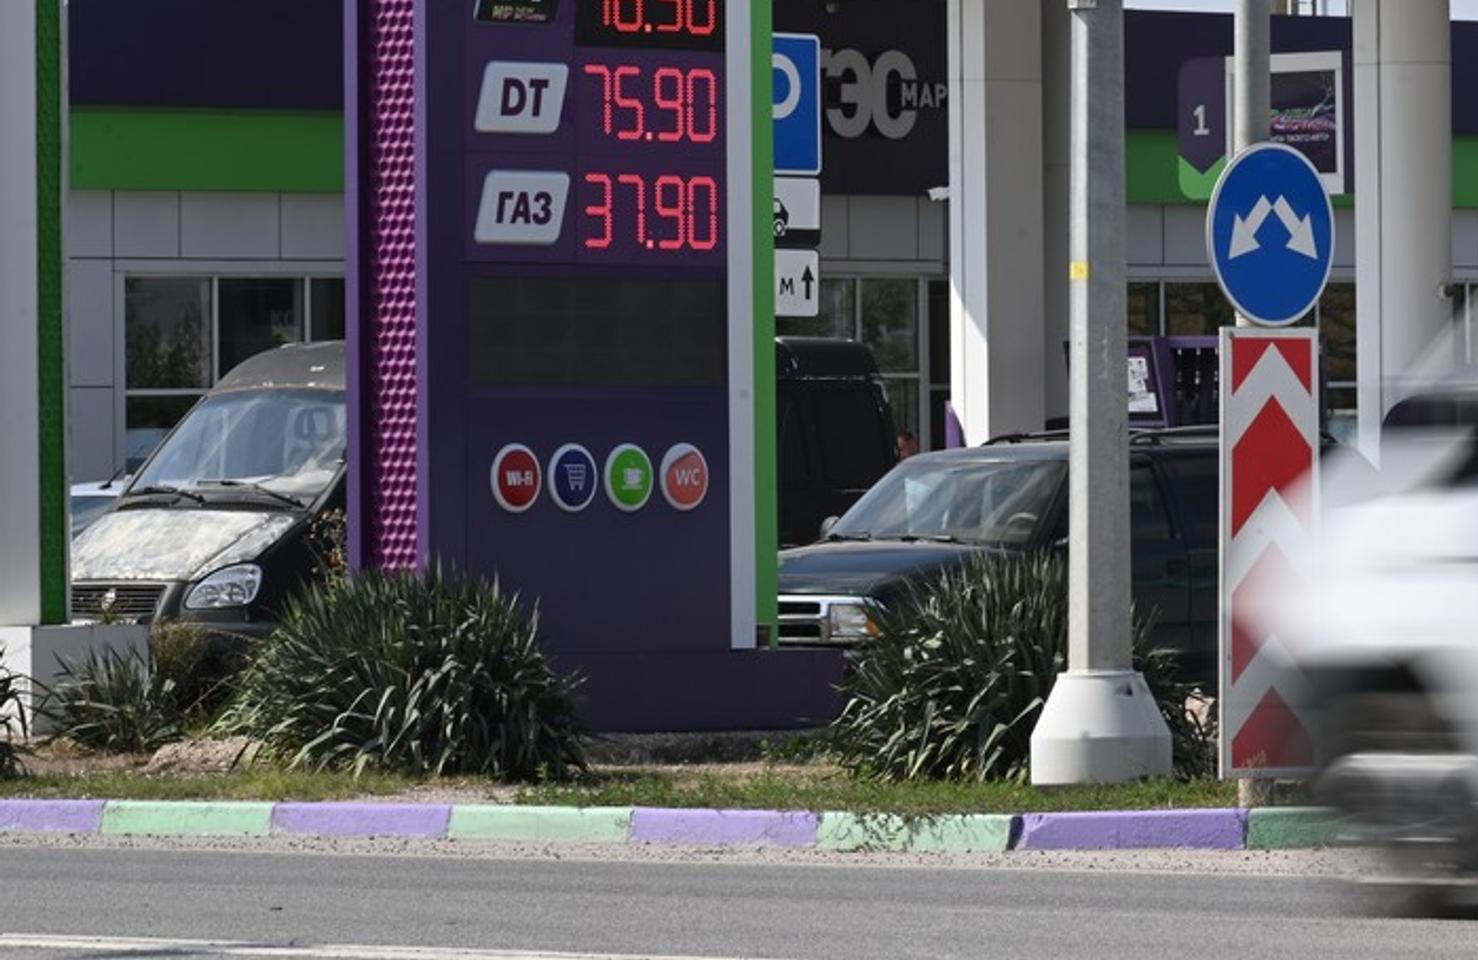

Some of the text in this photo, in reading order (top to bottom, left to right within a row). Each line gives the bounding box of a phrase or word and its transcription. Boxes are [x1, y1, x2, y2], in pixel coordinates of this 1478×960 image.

[500, 77, 549, 117] DT
[584, 63, 717, 144] 75.90
[1193, 105, 1210, 136] 1
[495, 173, 718, 251] ГАЗ 37.90
[675, 468, 701, 486] WC
